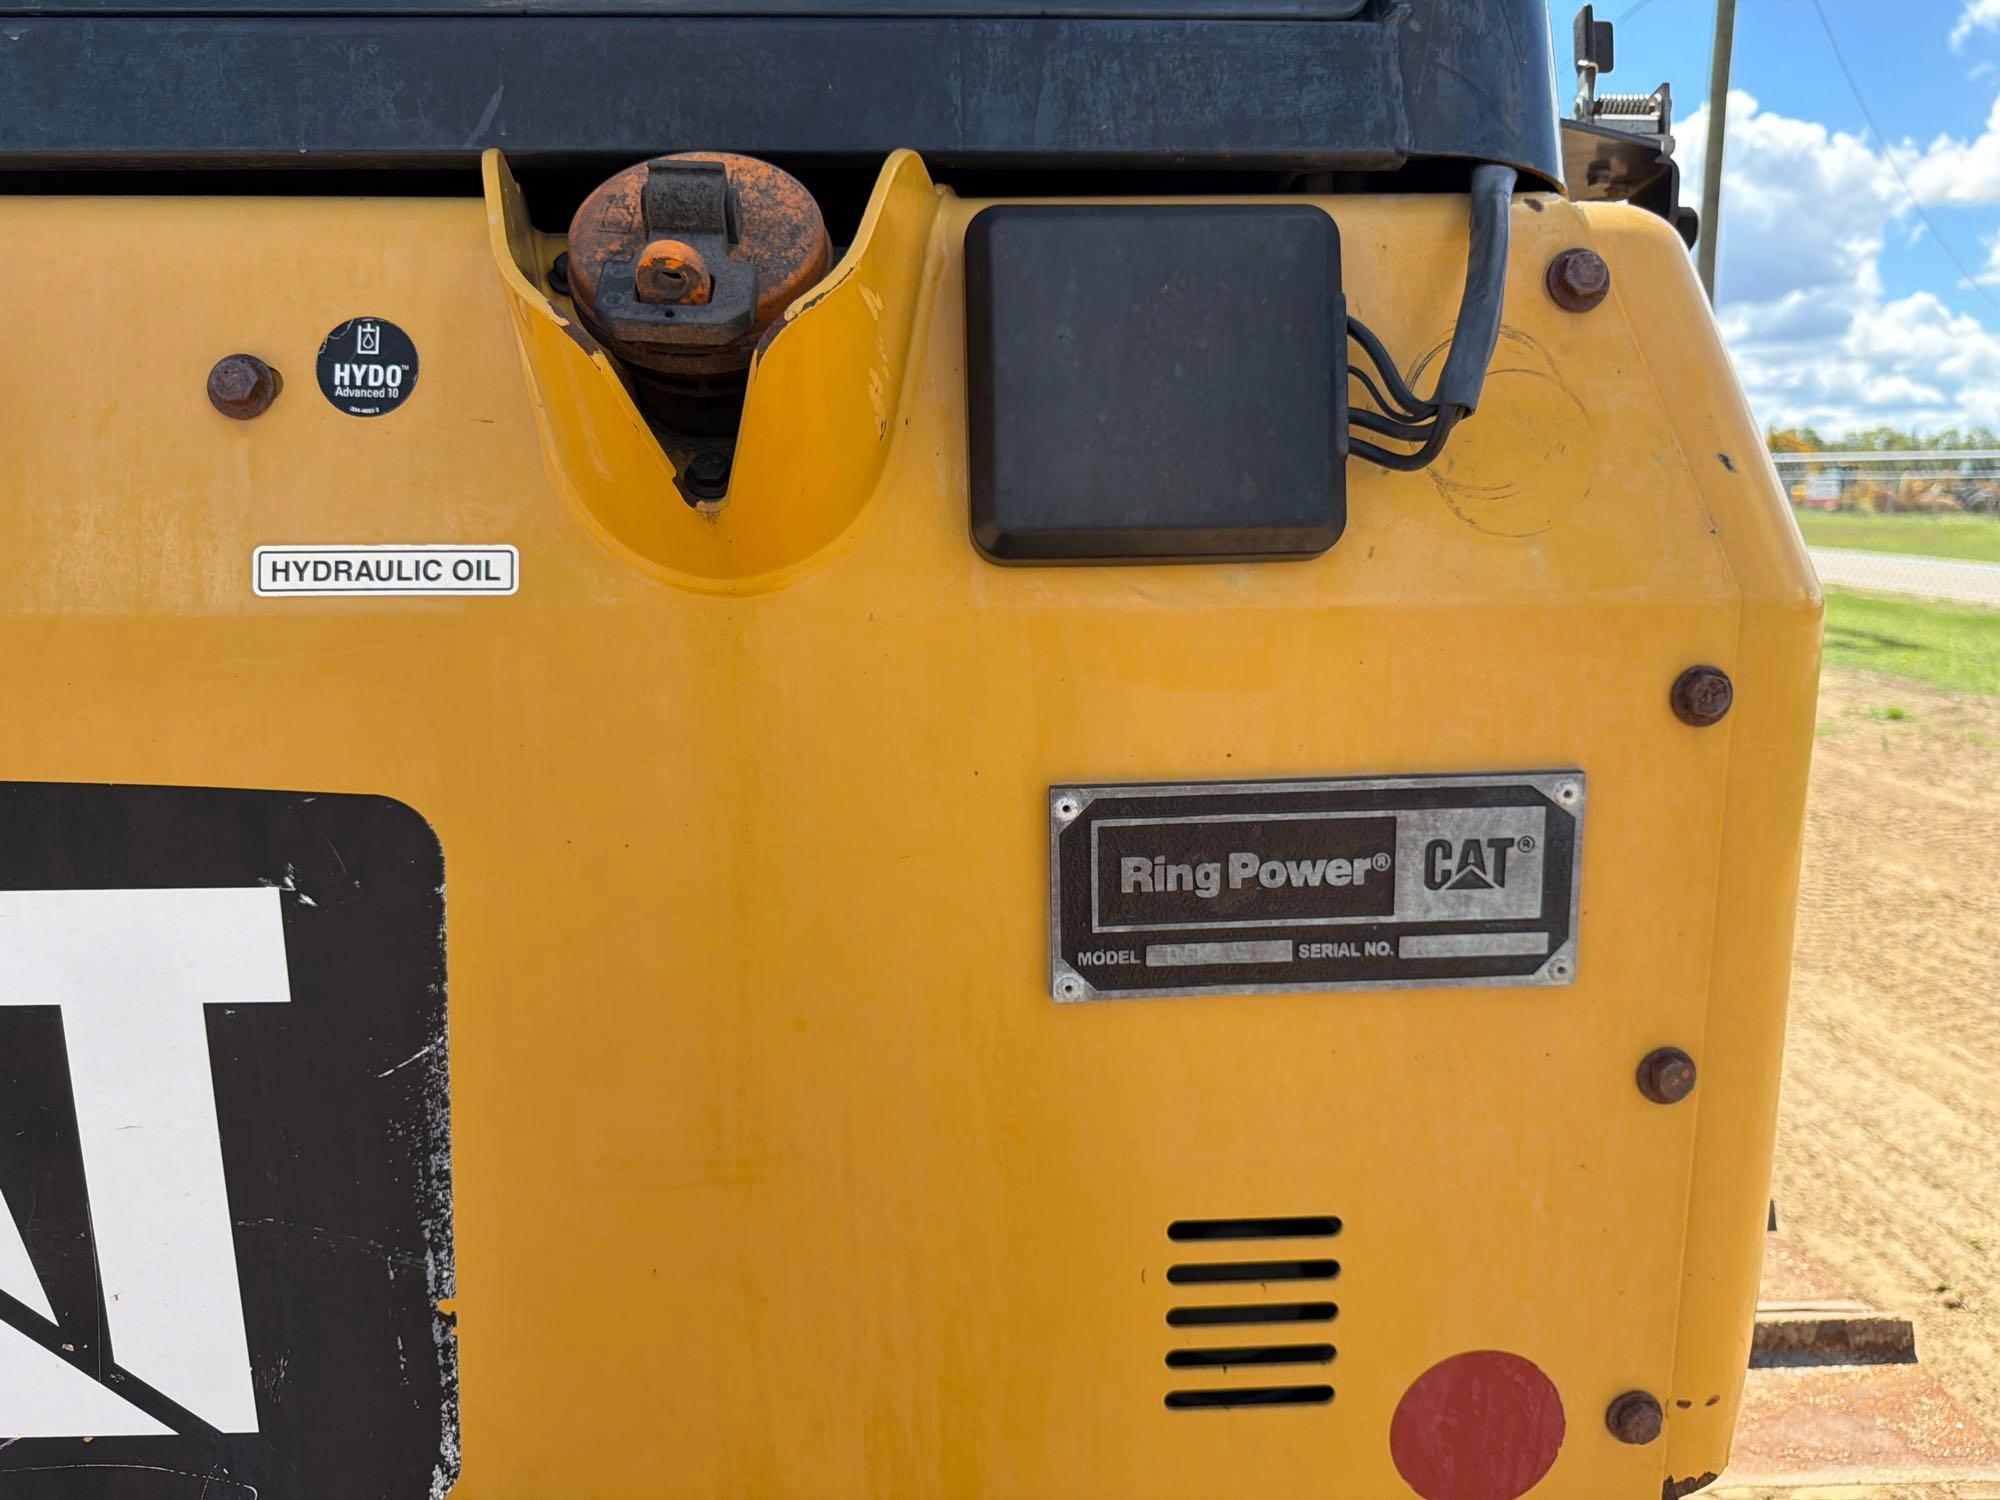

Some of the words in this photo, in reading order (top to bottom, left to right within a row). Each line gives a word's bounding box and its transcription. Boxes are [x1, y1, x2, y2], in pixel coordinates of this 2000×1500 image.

[334, 386, 386, 398] Advanced
[387, 387, 400, 399] 10
[271, 559, 443, 582] HYDRAULIC
[452, 559, 502, 582] OIL
[1120, 855, 1222, 898] Ring
[1077, 949, 1141, 966] MODEL
[1298, 942, 1361, 959] SERIAL
[1364, 940, 1395, 957] NO.
